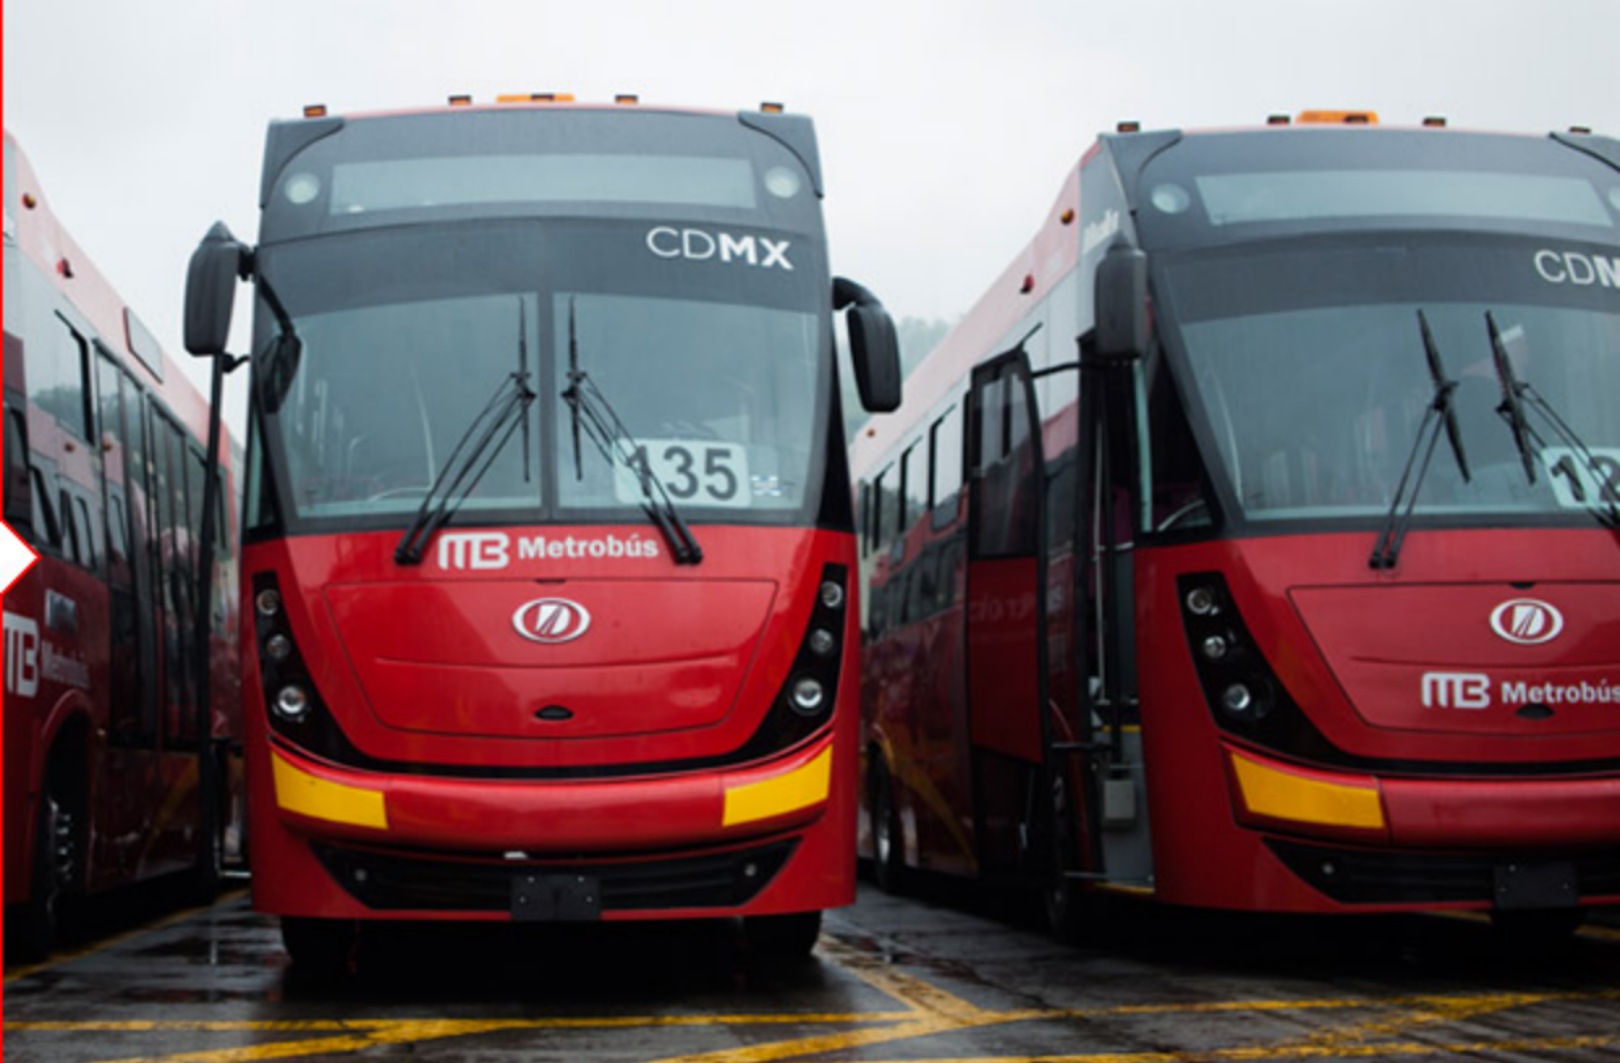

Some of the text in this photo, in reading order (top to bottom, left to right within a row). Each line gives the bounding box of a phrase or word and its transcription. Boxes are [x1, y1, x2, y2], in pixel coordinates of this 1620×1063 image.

[646, 226, 794, 270] CDMX
[625, 445, 738, 501] 135
[437, 532, 660, 571] MB Metrobús
[1421, 671, 1491, 709] MB
